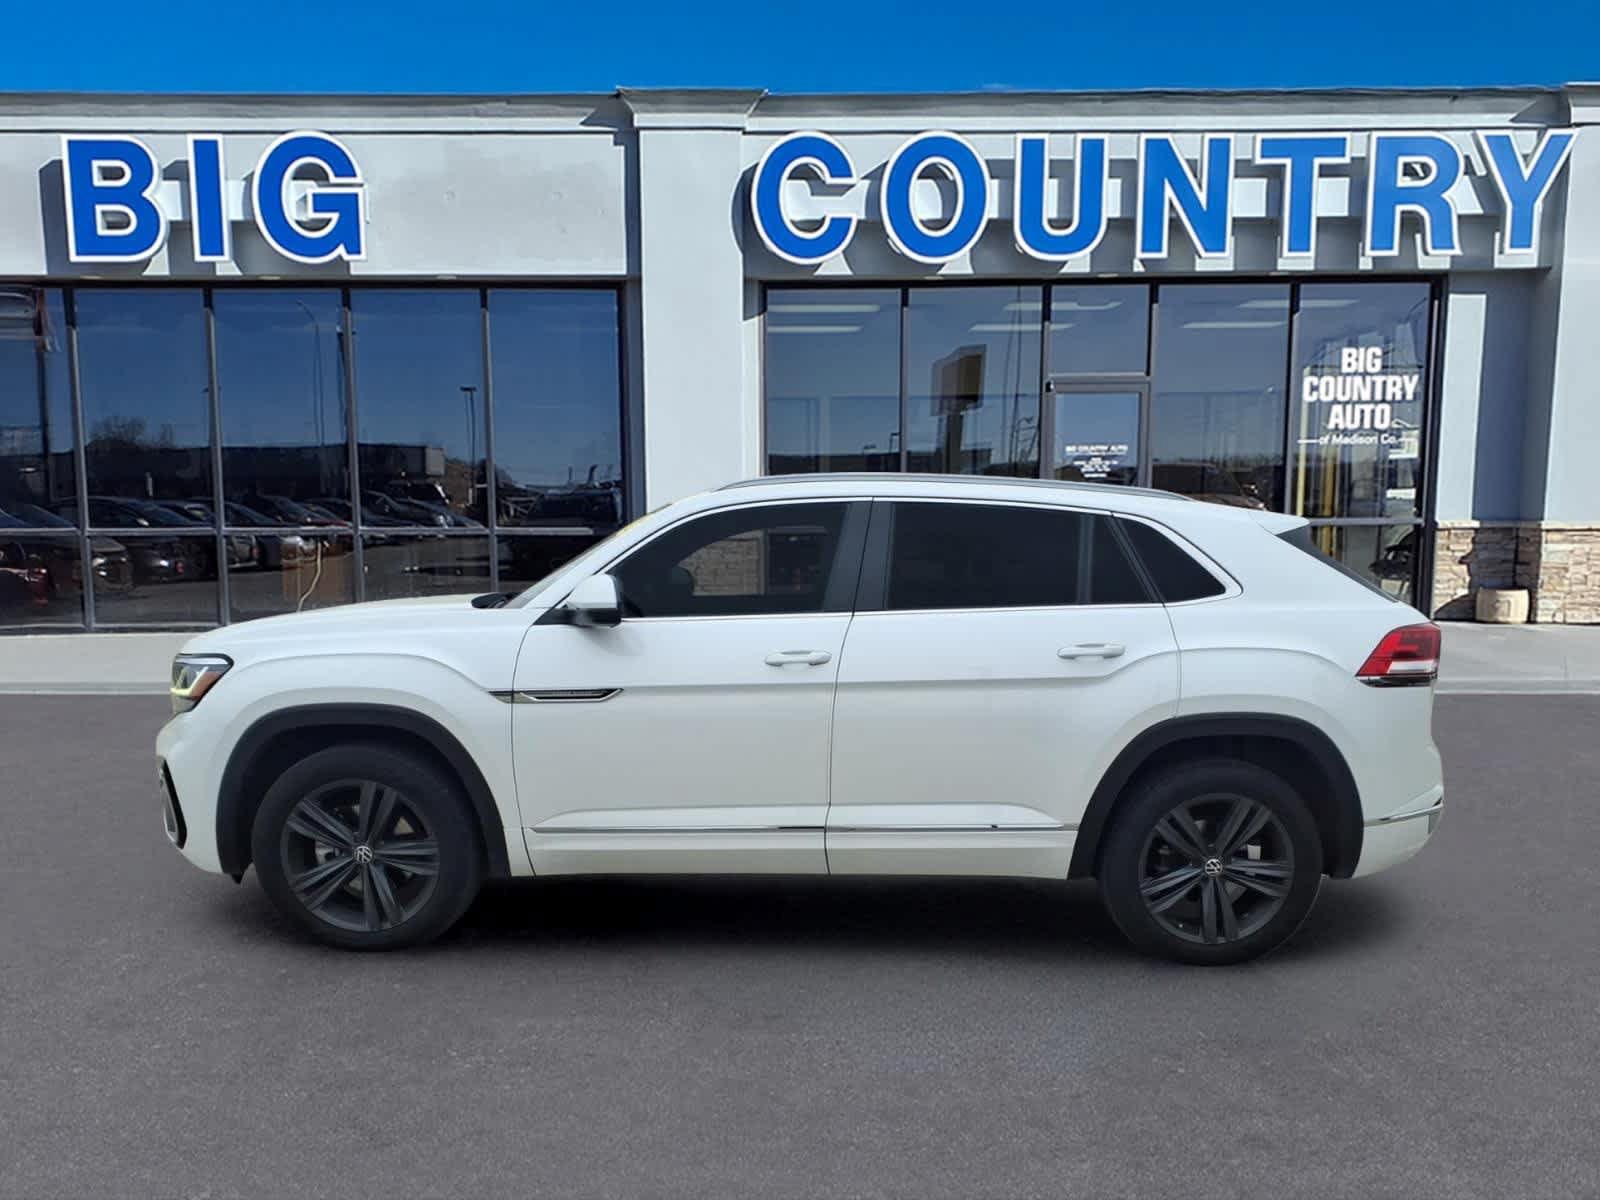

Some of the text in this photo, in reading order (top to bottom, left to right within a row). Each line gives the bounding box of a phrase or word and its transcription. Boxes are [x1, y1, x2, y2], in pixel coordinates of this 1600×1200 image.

[62, 130, 1573, 264] BIG COUNTRY
[1341, 347, 1383, 373] BIG
[1303, 375, 1419, 401] COUNTRY
[1328, 403, 1391, 429] AUTO
